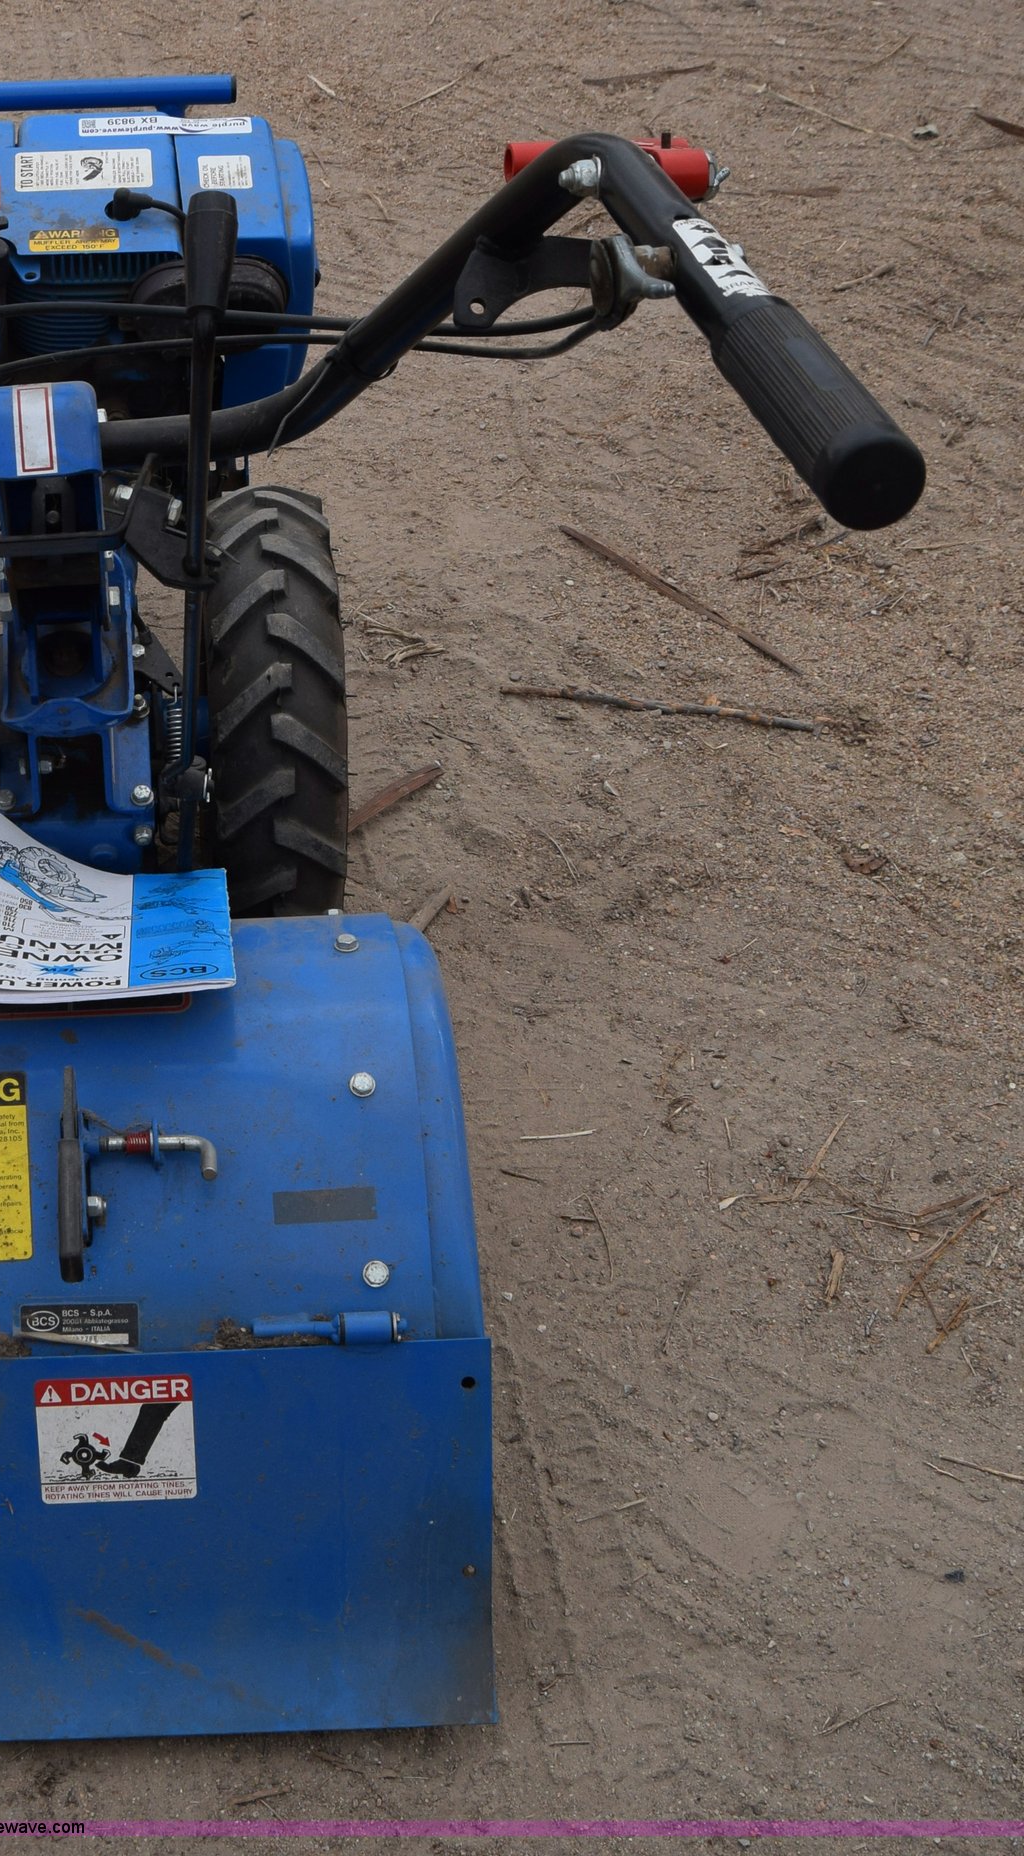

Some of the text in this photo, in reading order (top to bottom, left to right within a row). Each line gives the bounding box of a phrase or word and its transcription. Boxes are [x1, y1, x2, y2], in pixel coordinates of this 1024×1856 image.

[107, 116, 157, 126] BX 9839
[81, 125, 179, 134] www.purplewave.com
[20, 155, 34, 189] TO START
[20, 897, 34, 906] 850
[19, 903, 33, 911] 830
[2, 915, 16, 923] 716
[150, 965, 208, 978] BCS
[27, 979, 122, 989] POWER
[8, 1120, 25, 1128] from
[62, 1309, 80, 1318] BCS
[89, 1308, 113, 1318] S.p.A.
[31, 1316, 56, 1328] BCS
[83, 1317, 129, 1326] Abbiategrasso
[70, 1378, 190, 1403] DANGER
[44, 1486, 65, 1494] KEEP
[67, 1485, 89, 1493] AWAY
[92, 1483, 116, 1491] FROM
[118, 1482, 159, 1490] ROTATING
[45, 1487, 194, 1500] ROTATING TINES WILL CAUSE INJURY
